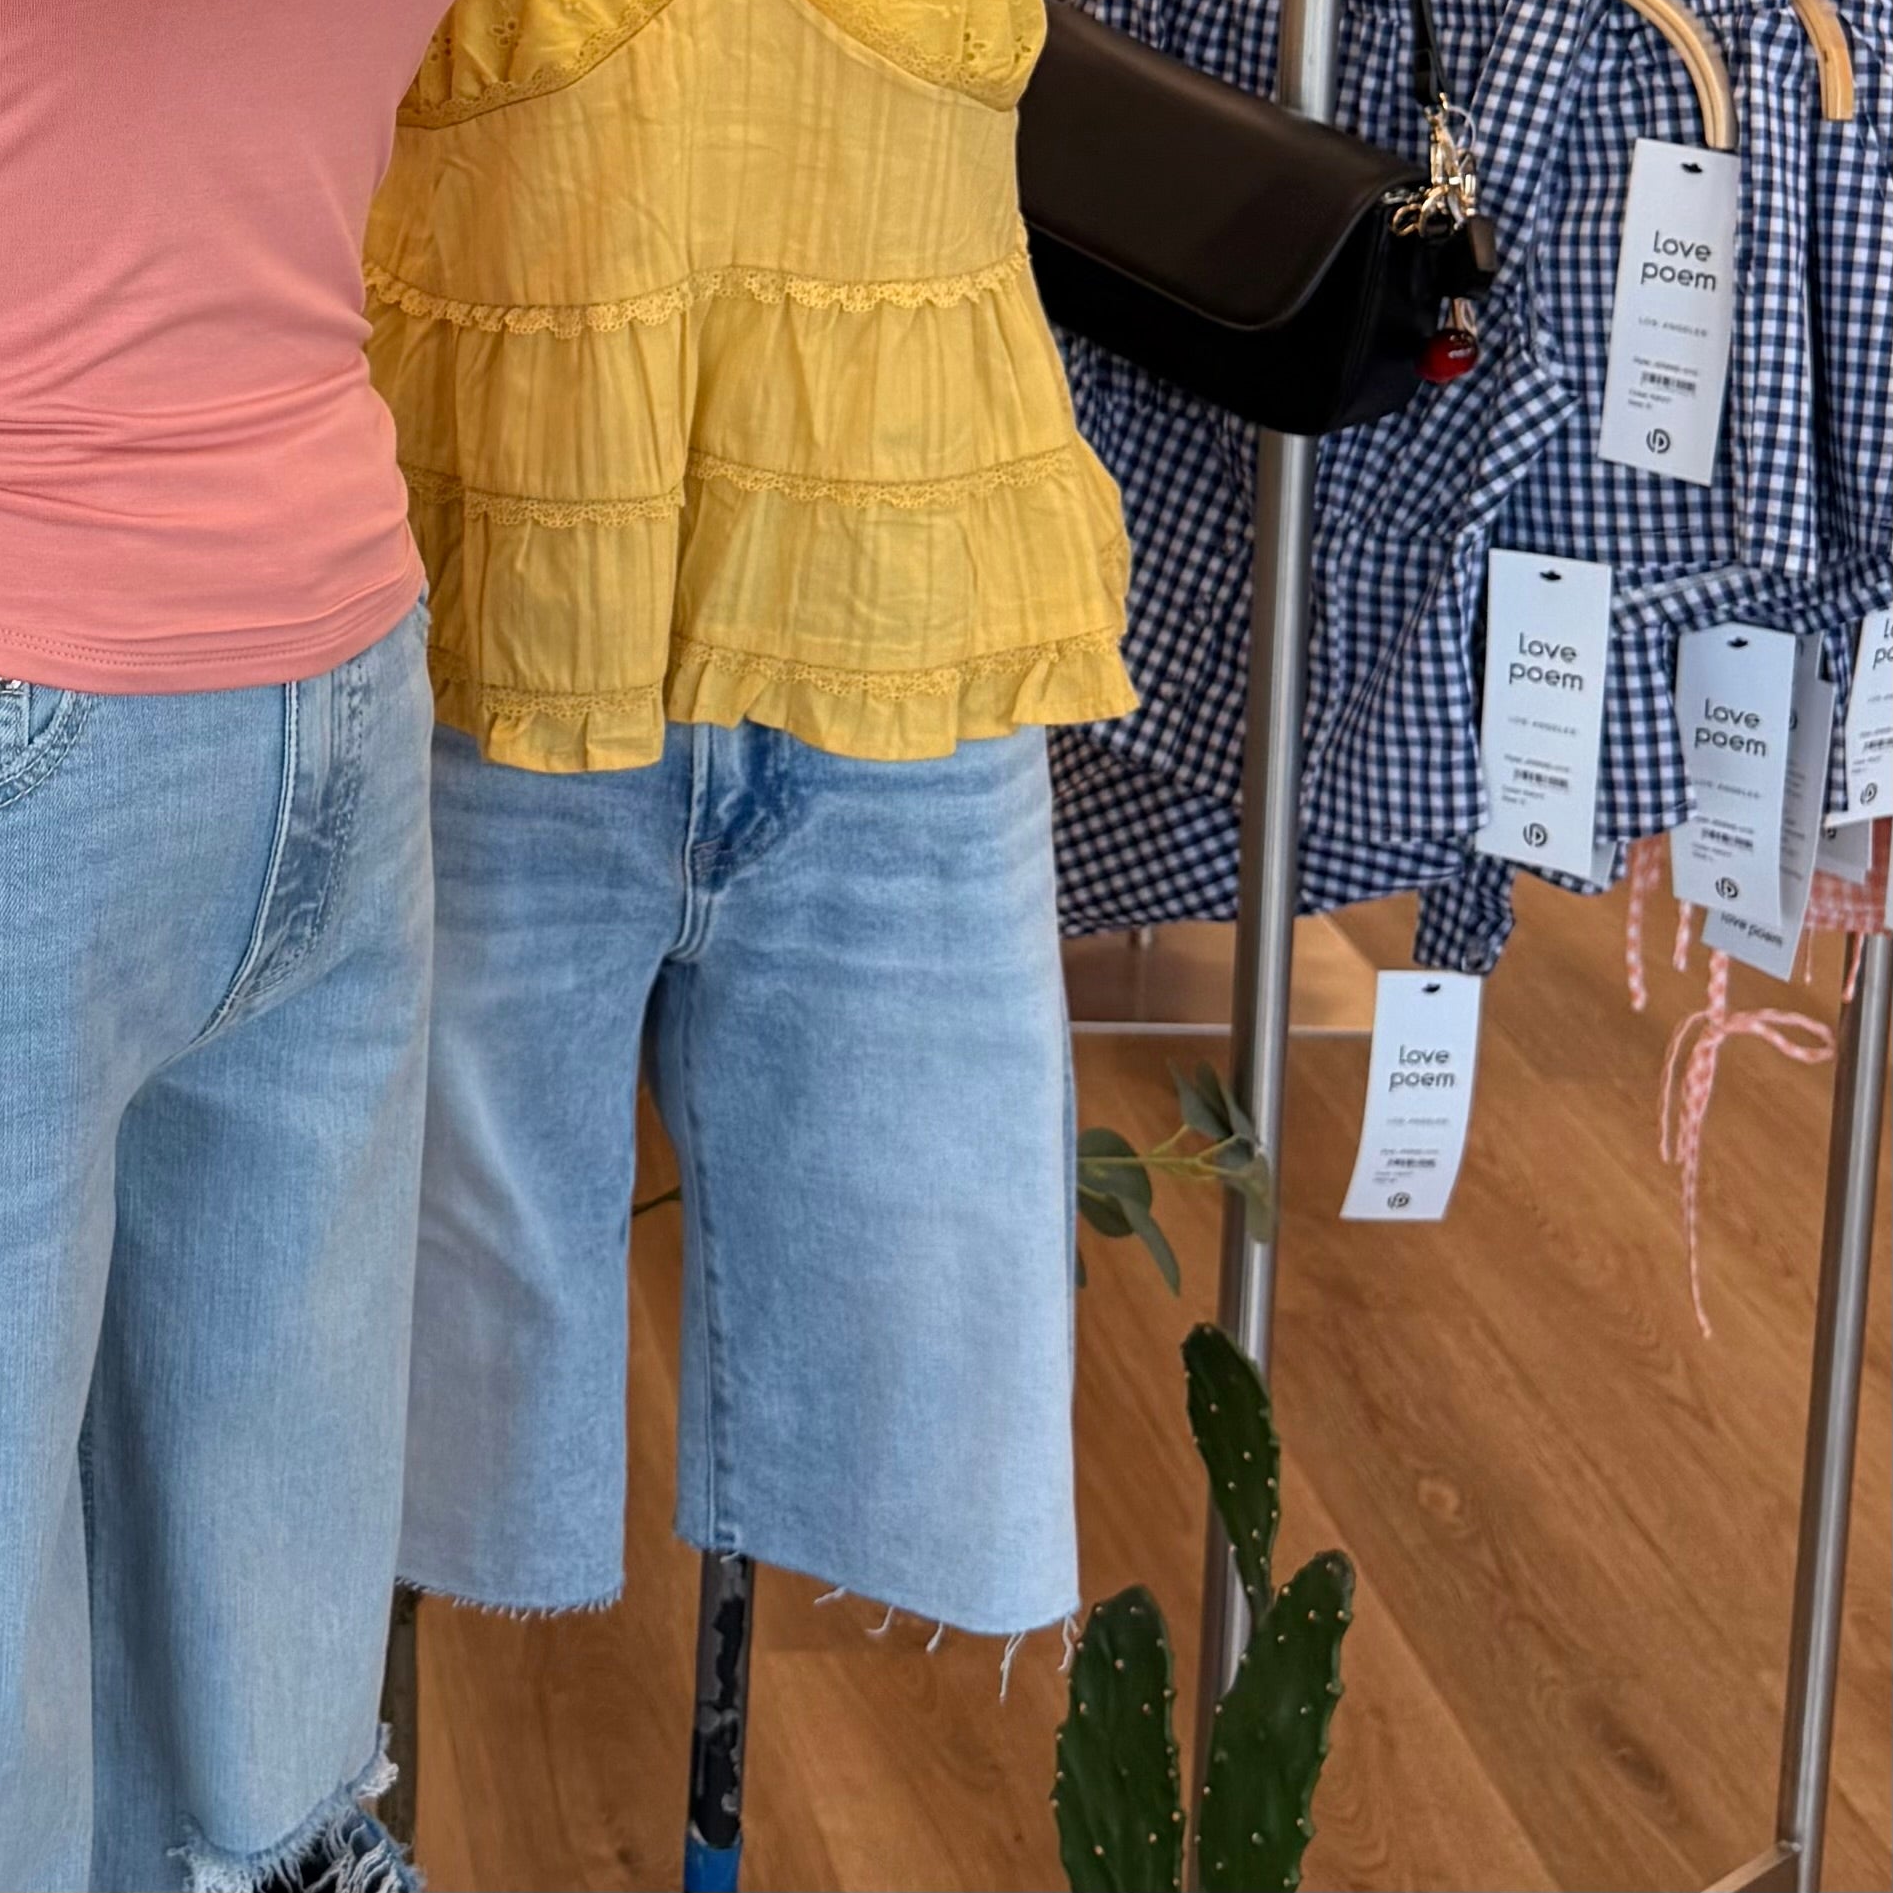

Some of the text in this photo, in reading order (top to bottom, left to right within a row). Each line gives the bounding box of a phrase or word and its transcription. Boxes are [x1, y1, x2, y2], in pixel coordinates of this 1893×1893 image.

[1653, 229, 1711, 262] love
[1640, 261, 1717, 292] poem
[1519, 632, 1577, 663] love
[1508, 662, 1584, 692] poem
[1705, 698, 1761, 730] love
[1694, 727, 1767, 758] poem
[1399, 1045, 1451, 1066] love
[1388, 1070, 1456, 1093] poem
